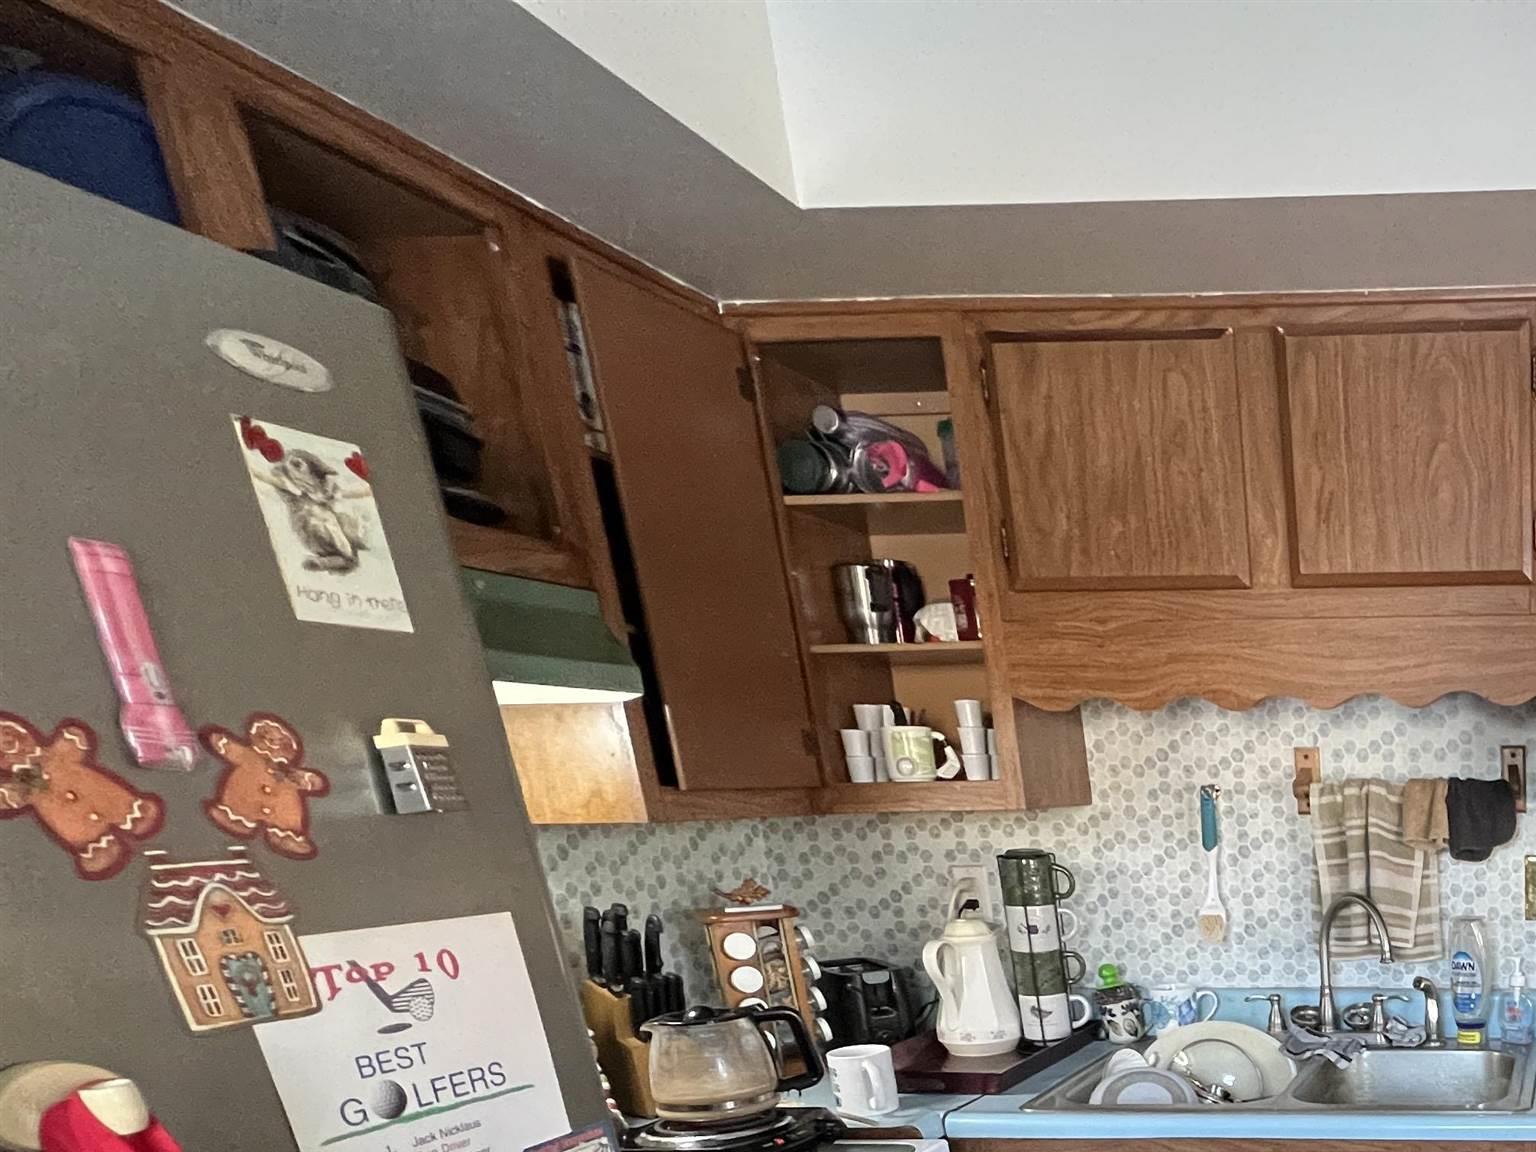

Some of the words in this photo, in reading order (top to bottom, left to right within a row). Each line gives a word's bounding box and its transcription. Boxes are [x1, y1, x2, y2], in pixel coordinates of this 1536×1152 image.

[297, 585, 340, 609] Hang
[346, 591, 363, 607] in
[414, 948, 460, 980] 10
[1451, 960, 1475, 971] DAWN
[355, 1041, 427, 1079] BEST
[412, 1133, 437, 1148] Jack
[439, 1120, 482, 1139] Nicklaus
